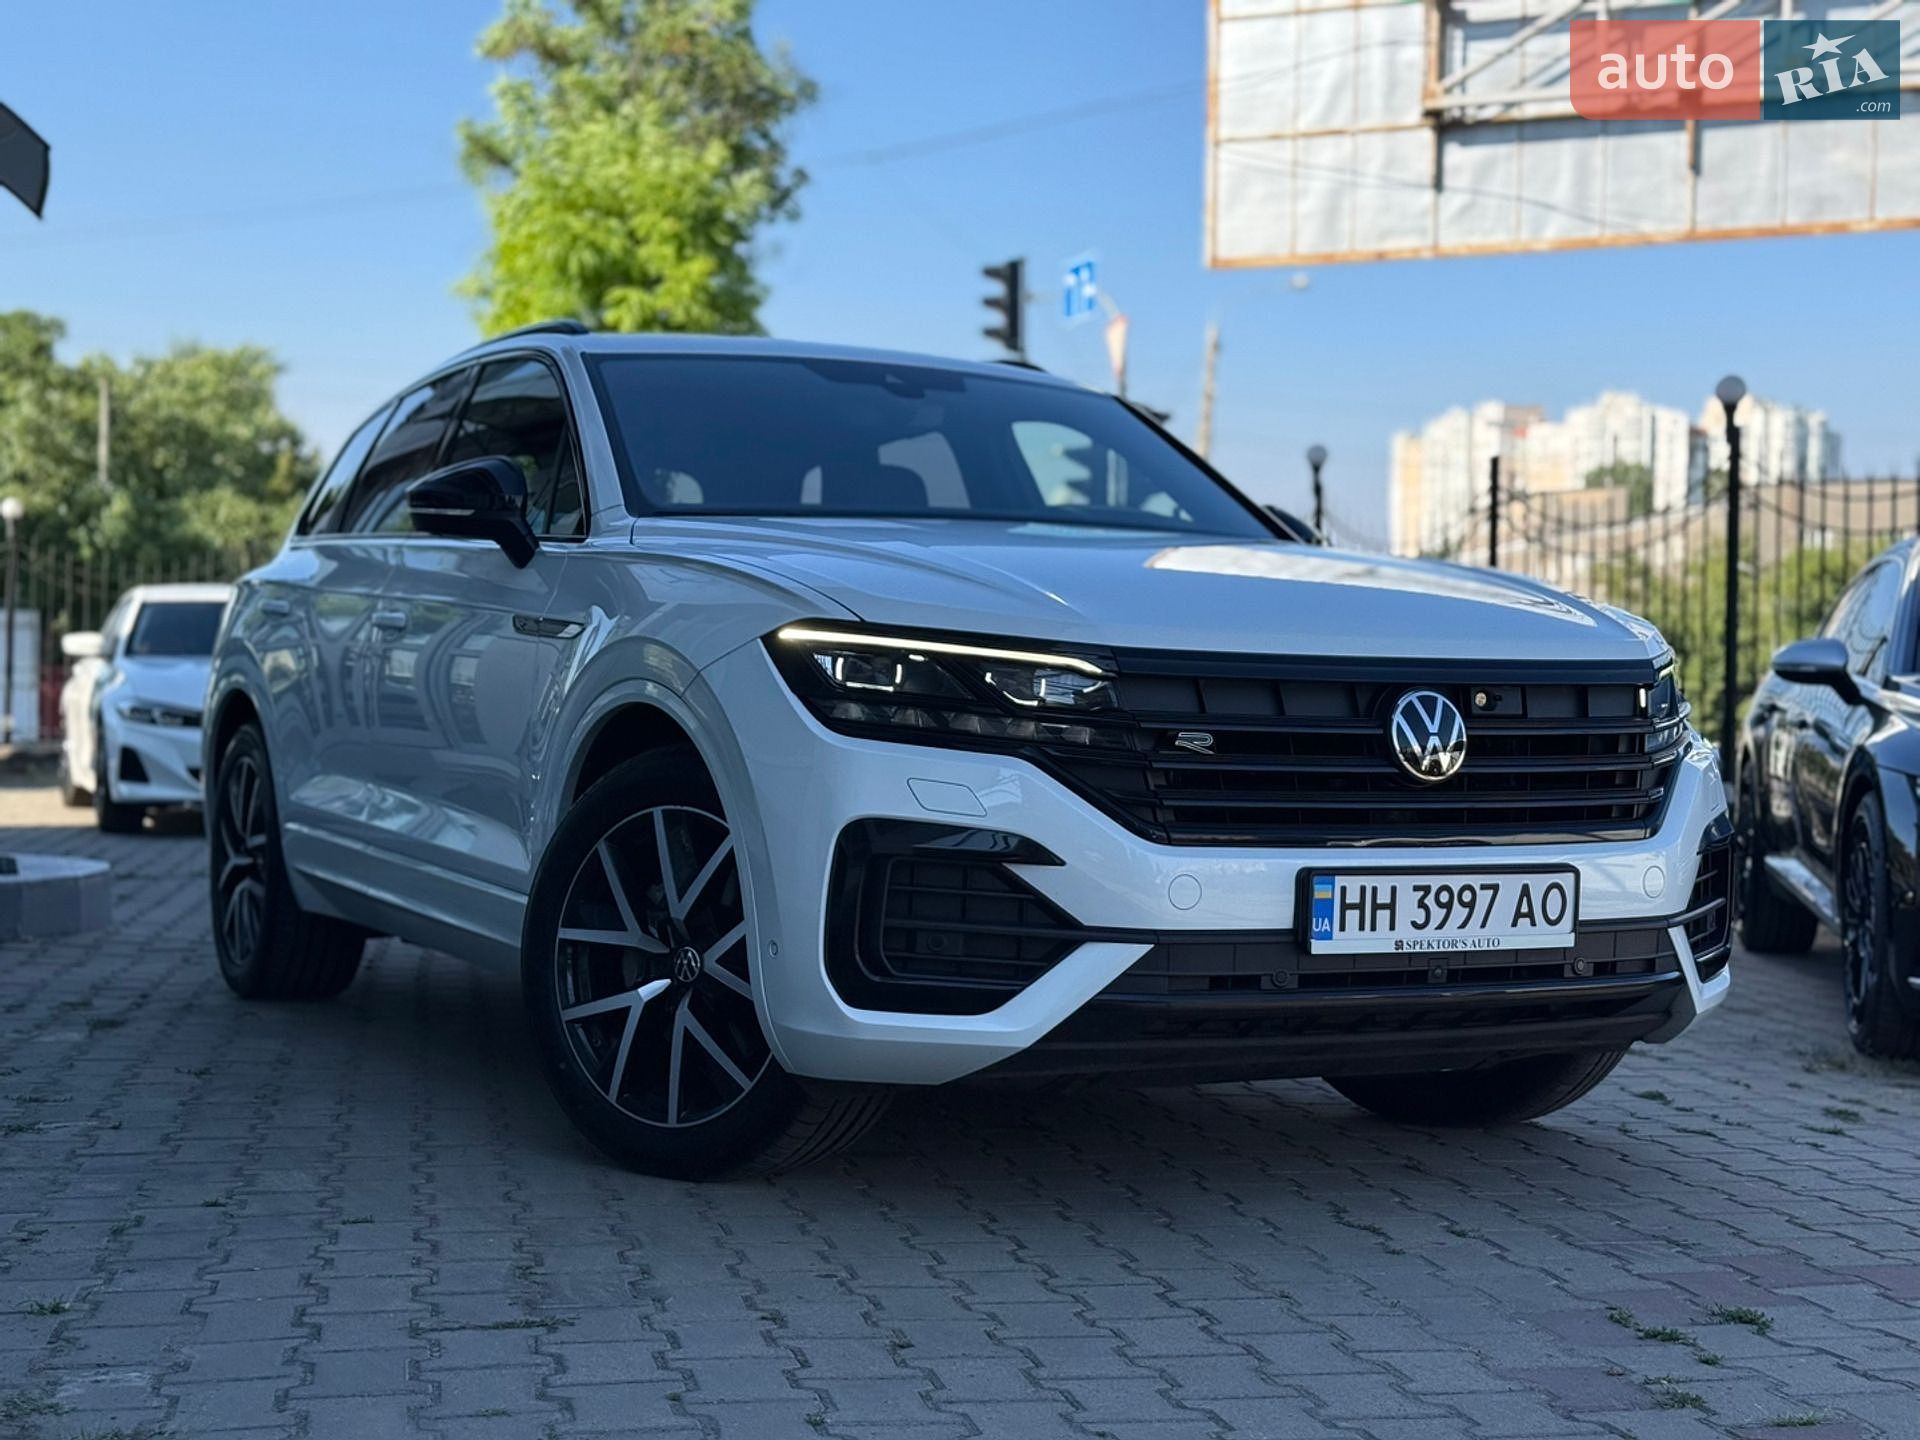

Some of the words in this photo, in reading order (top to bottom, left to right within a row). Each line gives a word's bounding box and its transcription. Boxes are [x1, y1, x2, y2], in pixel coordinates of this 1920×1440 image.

[1338, 885, 1398, 932] HH
[1410, 882, 1500, 931] 3997
[1510, 881, 1568, 928] AO
[1312, 917, 1331, 932] UA
[1405, 938, 1468, 950] SPEKTOR'S
[1469, 937, 1501, 948] AUTO
